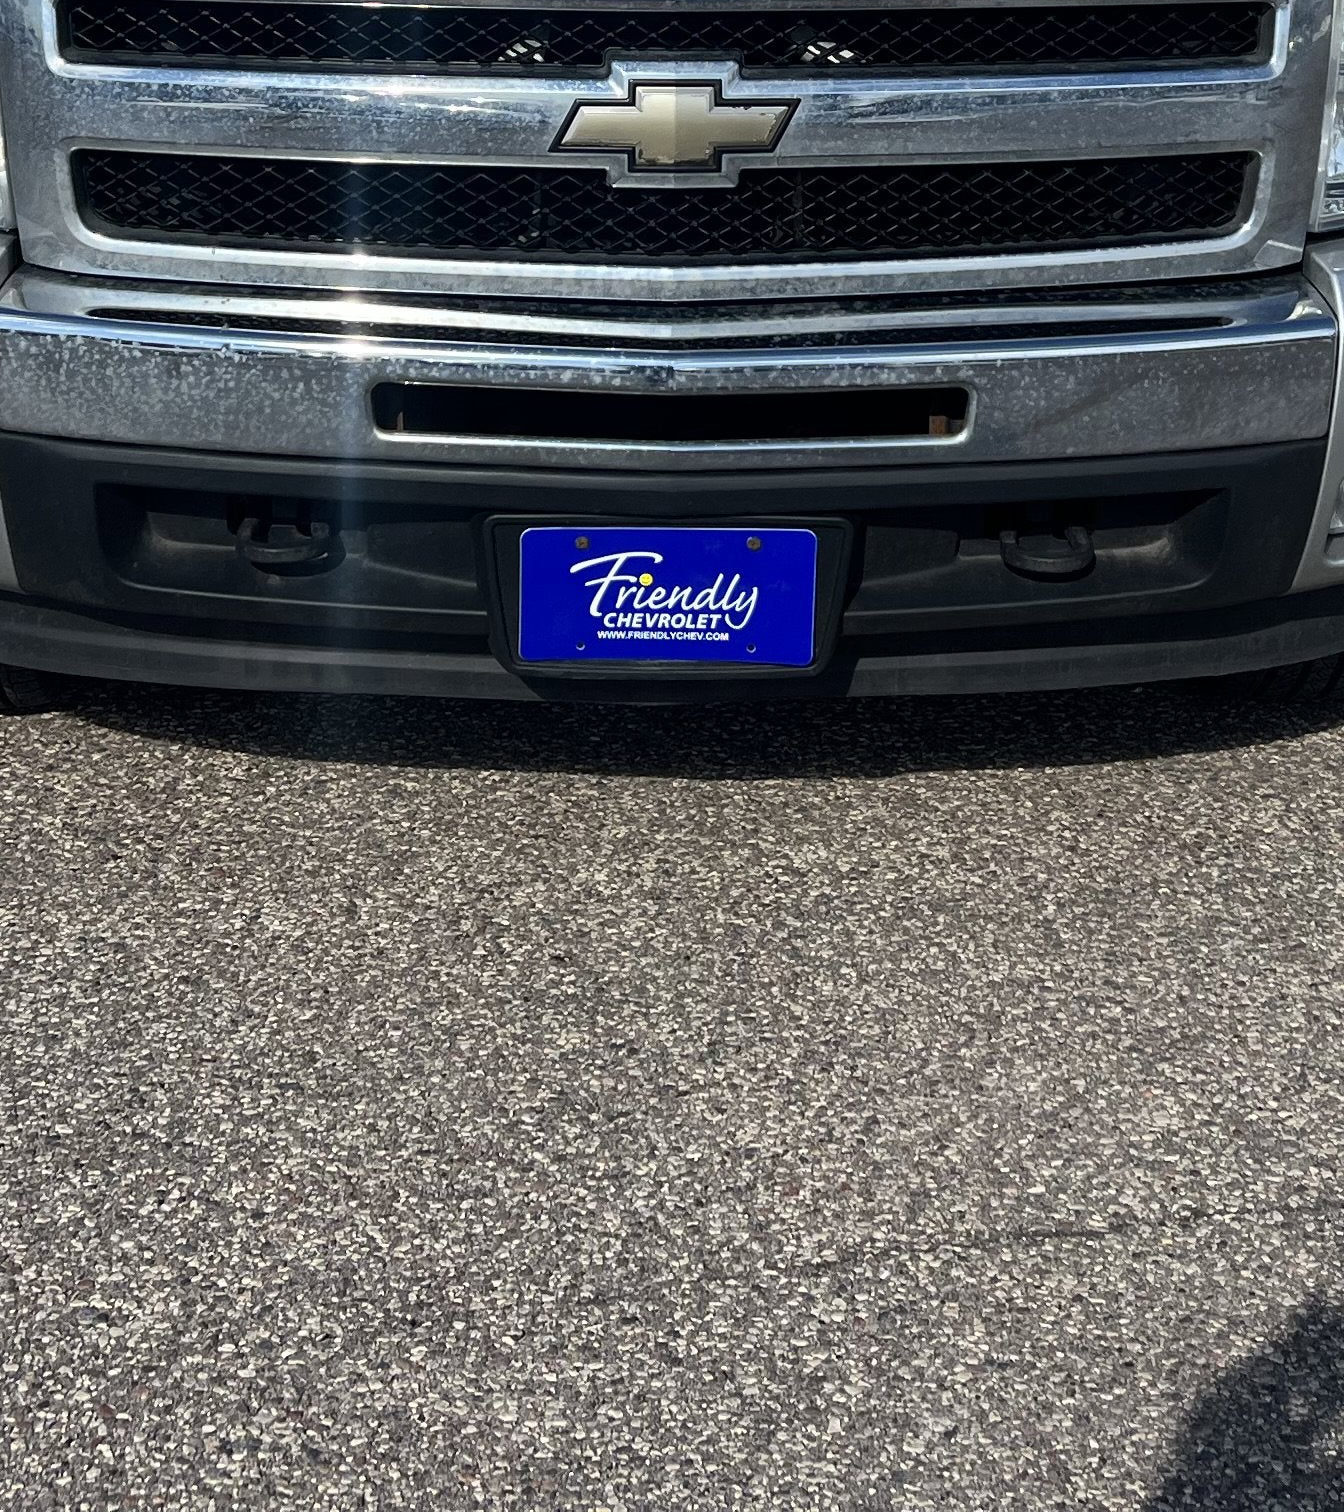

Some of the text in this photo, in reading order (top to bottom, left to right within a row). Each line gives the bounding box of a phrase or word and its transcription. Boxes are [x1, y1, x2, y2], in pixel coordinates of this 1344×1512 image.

[570, 551, 758, 630] Friendly
[604, 612, 722, 629] CHEVROLET
[597, 630, 729, 641] WWW.FRIENDLYCHEV.COM
